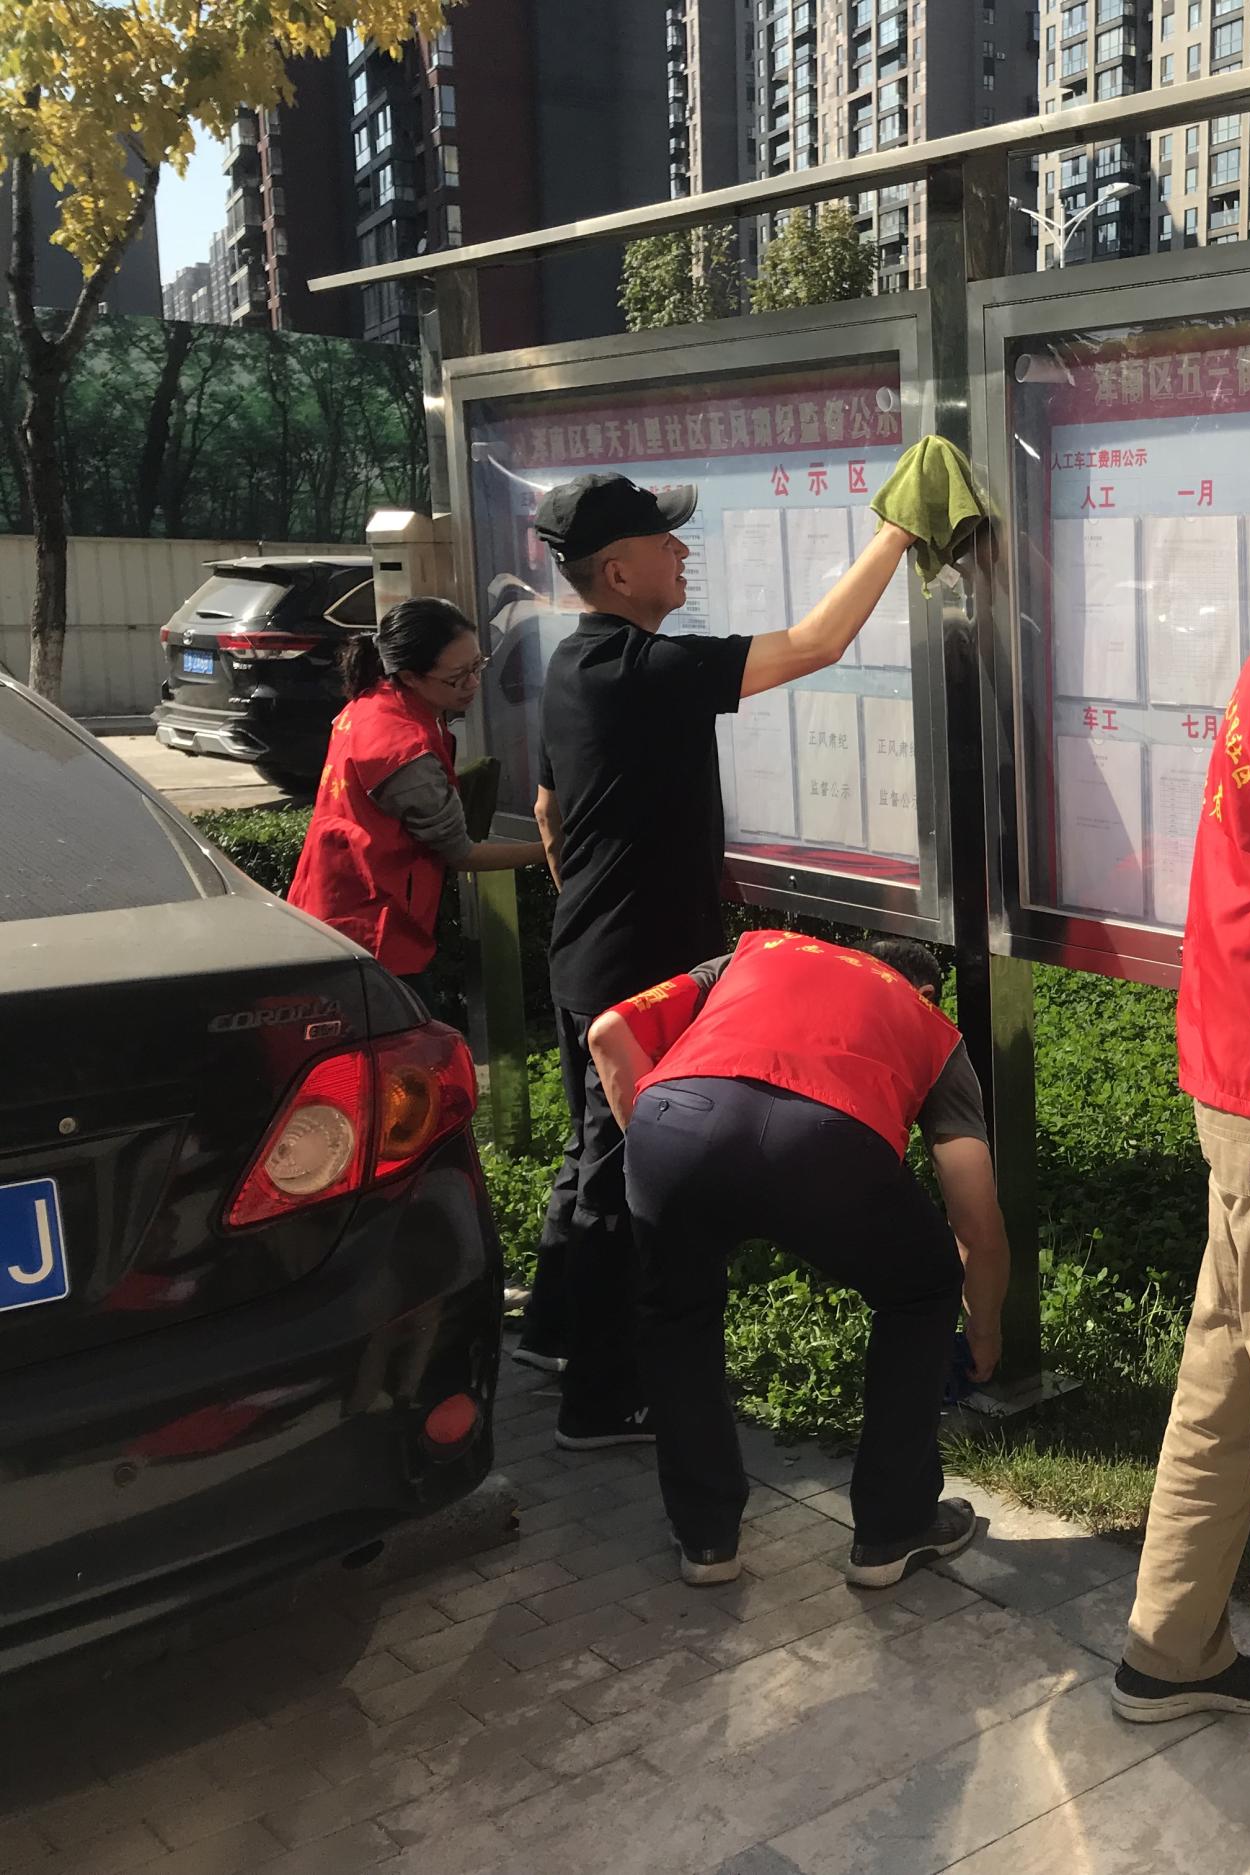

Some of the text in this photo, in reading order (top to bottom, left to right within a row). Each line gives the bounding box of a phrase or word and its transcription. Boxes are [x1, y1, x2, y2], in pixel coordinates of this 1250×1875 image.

[1051, 448, 1148, 470] 人工车工费用公示
[771, 459, 868, 497] 公示区
[1080, 485, 1116, 510] 人工
[1177, 480, 1213, 507] 一月
[1083, 706, 1119, 732] 车工
[1181, 713, 1217, 741] 七月
[808, 730, 849, 752] 正风肃纪
[810, 779, 849, 801] 监督公示
